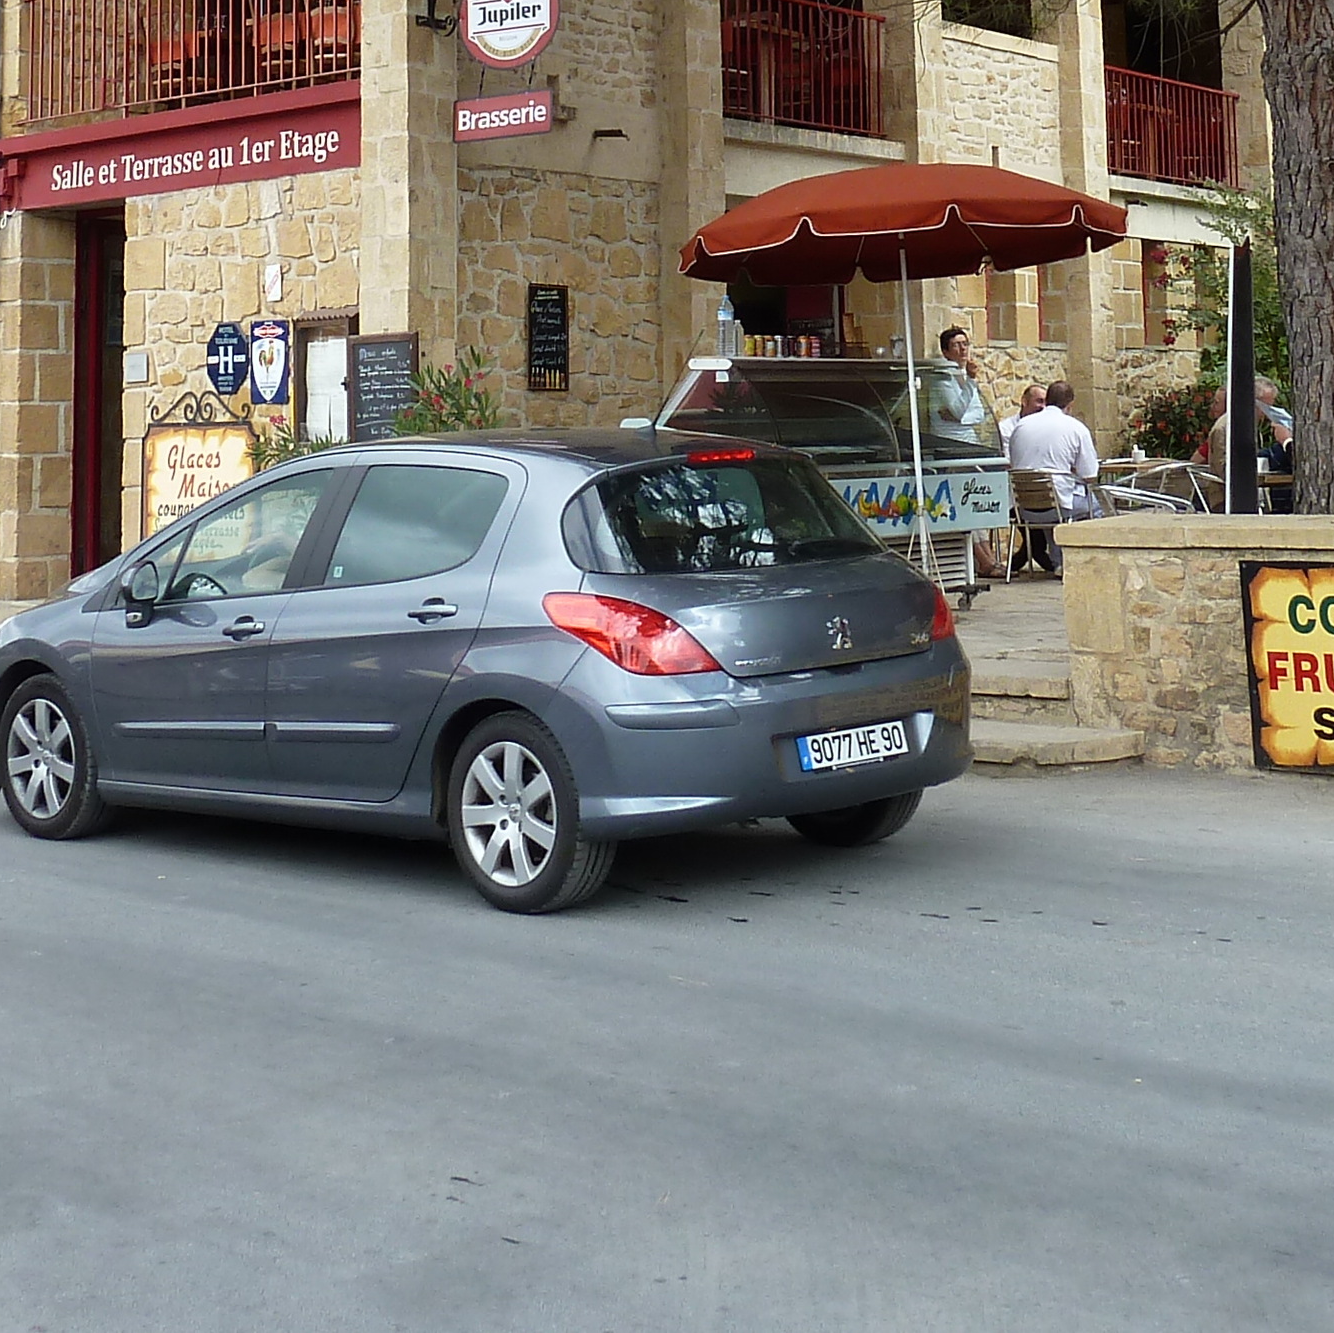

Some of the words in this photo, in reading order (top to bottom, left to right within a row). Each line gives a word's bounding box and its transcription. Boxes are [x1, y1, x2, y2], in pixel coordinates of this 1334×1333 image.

[478, 2, 542, 27] Jupiler
[458, 99, 547, 132] Brasserie
[50, 159, 94, 191] Salle
[98, 160, 118, 185] et
[121, 150, 204, 183] Terrasse
[208, 145, 234, 170] au
[239, 136, 275, 166] 1er
[279, 129, 340, 164] Etage
[218, 346, 234, 374] H
[167, 444, 221, 481] Glaces
[177, 473, 238, 500] Maiso
[810, 734, 853, 764] 9077
[856, 729, 880, 756] HE
[881, 725, 904, 751] 90
